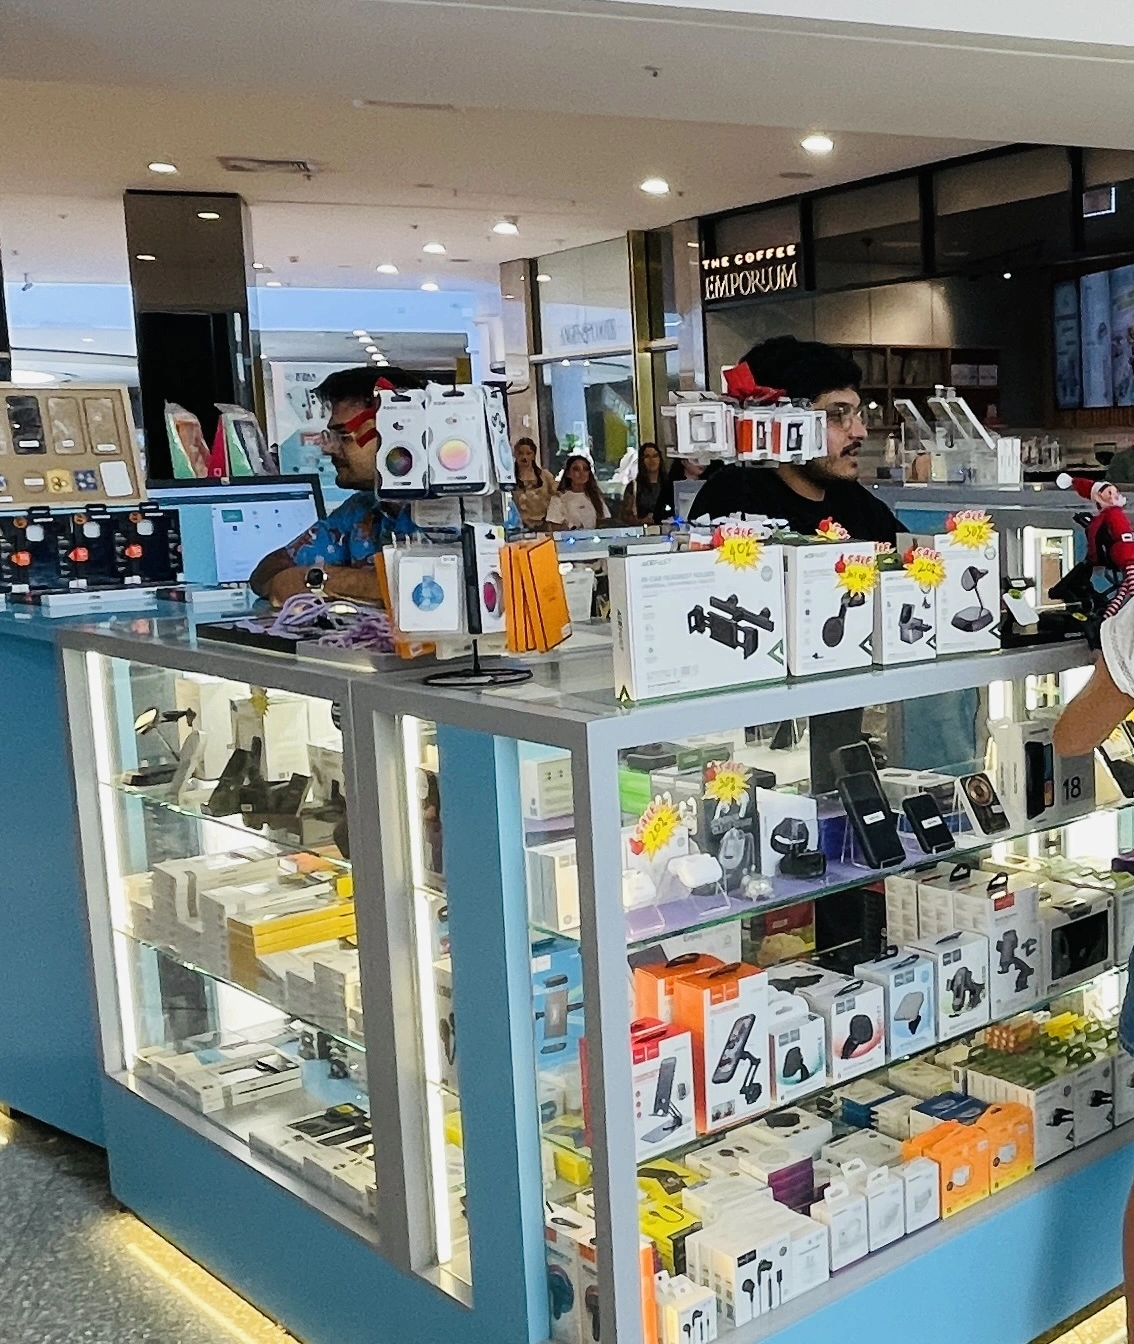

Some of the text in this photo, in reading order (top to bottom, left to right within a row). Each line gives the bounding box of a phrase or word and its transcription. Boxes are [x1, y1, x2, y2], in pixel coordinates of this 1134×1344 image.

[702, 244, 797, 270] THE COFFEE
[704, 262, 798, 300] EMPORIUM
[956, 509, 986, 521] SALE
[726, 527, 754, 539] SALE
[847, 554, 872, 565] SALE
[916, 546, 942, 561] SALE
[1063, 776, 1081, 801] 18
